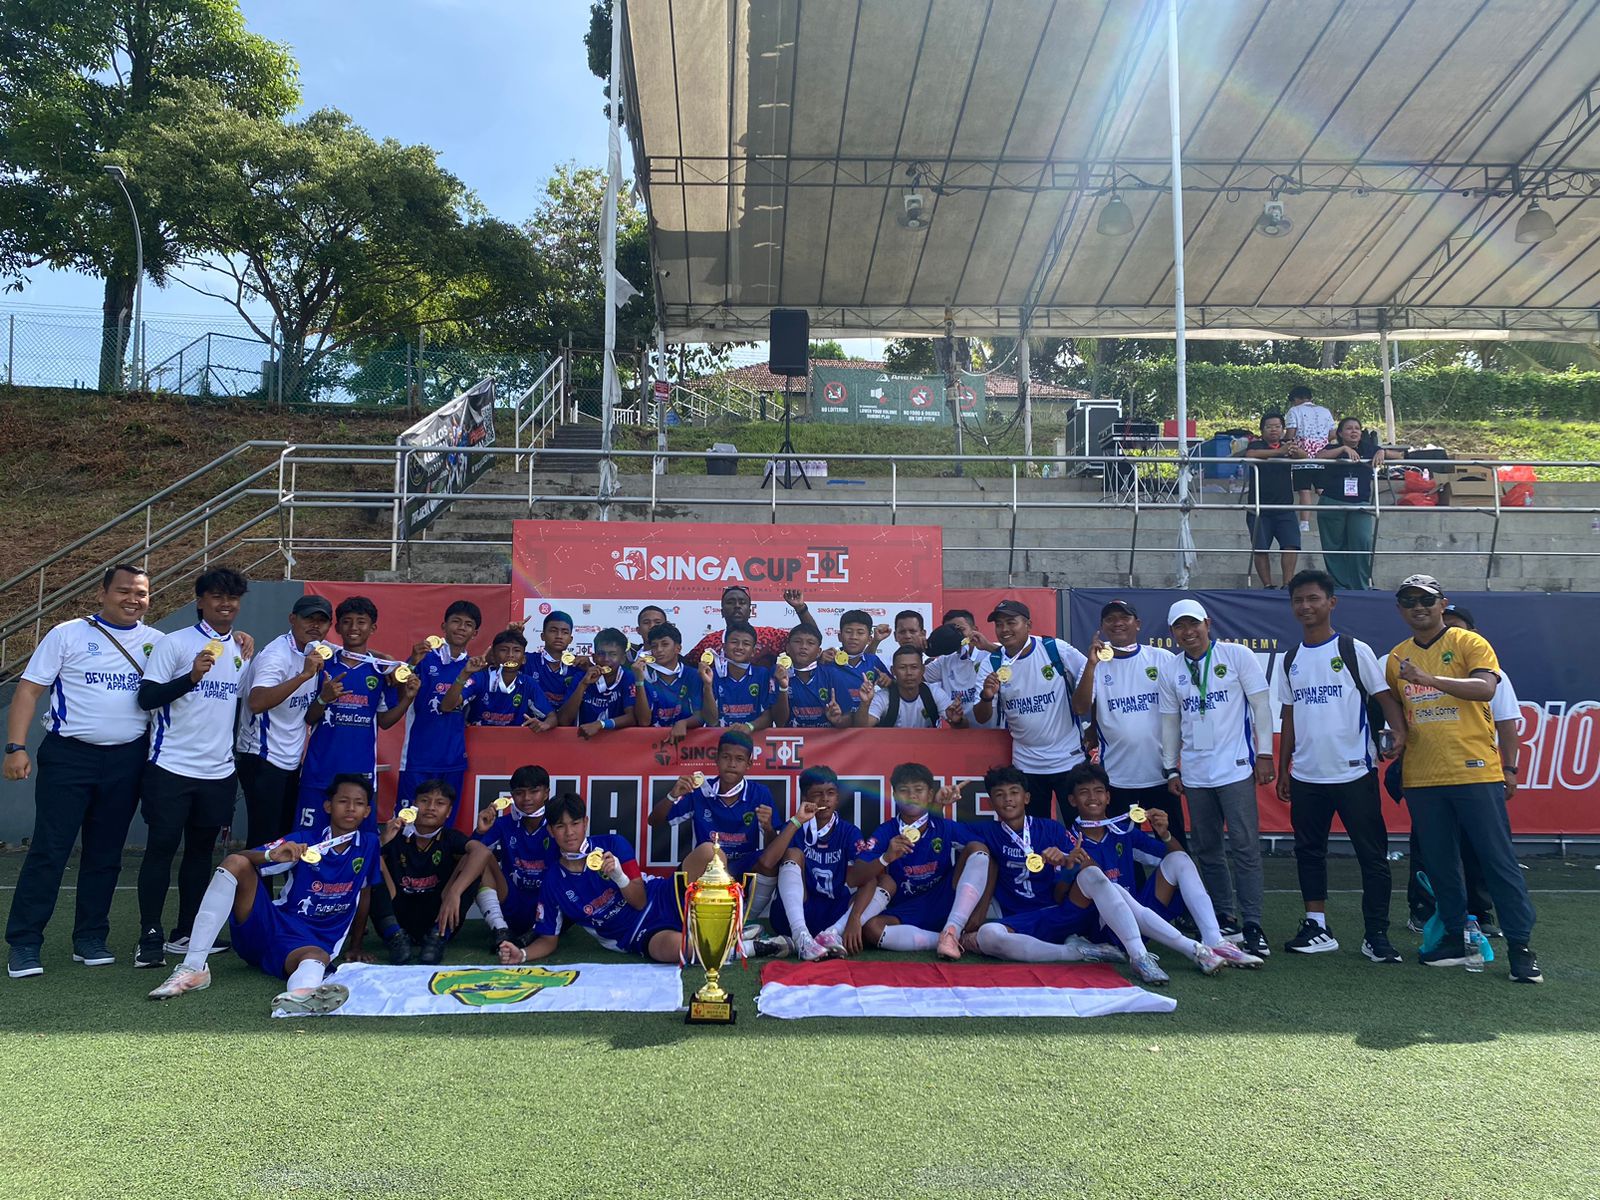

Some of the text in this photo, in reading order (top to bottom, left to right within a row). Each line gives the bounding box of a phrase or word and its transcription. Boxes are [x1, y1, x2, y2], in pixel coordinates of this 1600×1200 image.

[650, 556, 802, 582] SINGACUP
[85, 672, 126, 685] DEVHAN
[106, 682, 139, 691] APPAREL
[192, 680, 238, 695] EVHAN SPOR
[1318, 685, 1342, 698] SPORT
[204, 690, 228, 701] APPAREL
[1033, 691, 1056, 705] SPORT
[1107, 692, 1159, 712] DEVHAN SPORT
[1206, 690, 1228, 703] SPORT
[1018, 704, 1046, 715] APPAREL
[1122, 703, 1149, 714] APPAREL
[354, 713, 371, 723] Corner
[300, 807, 315, 826] 15
